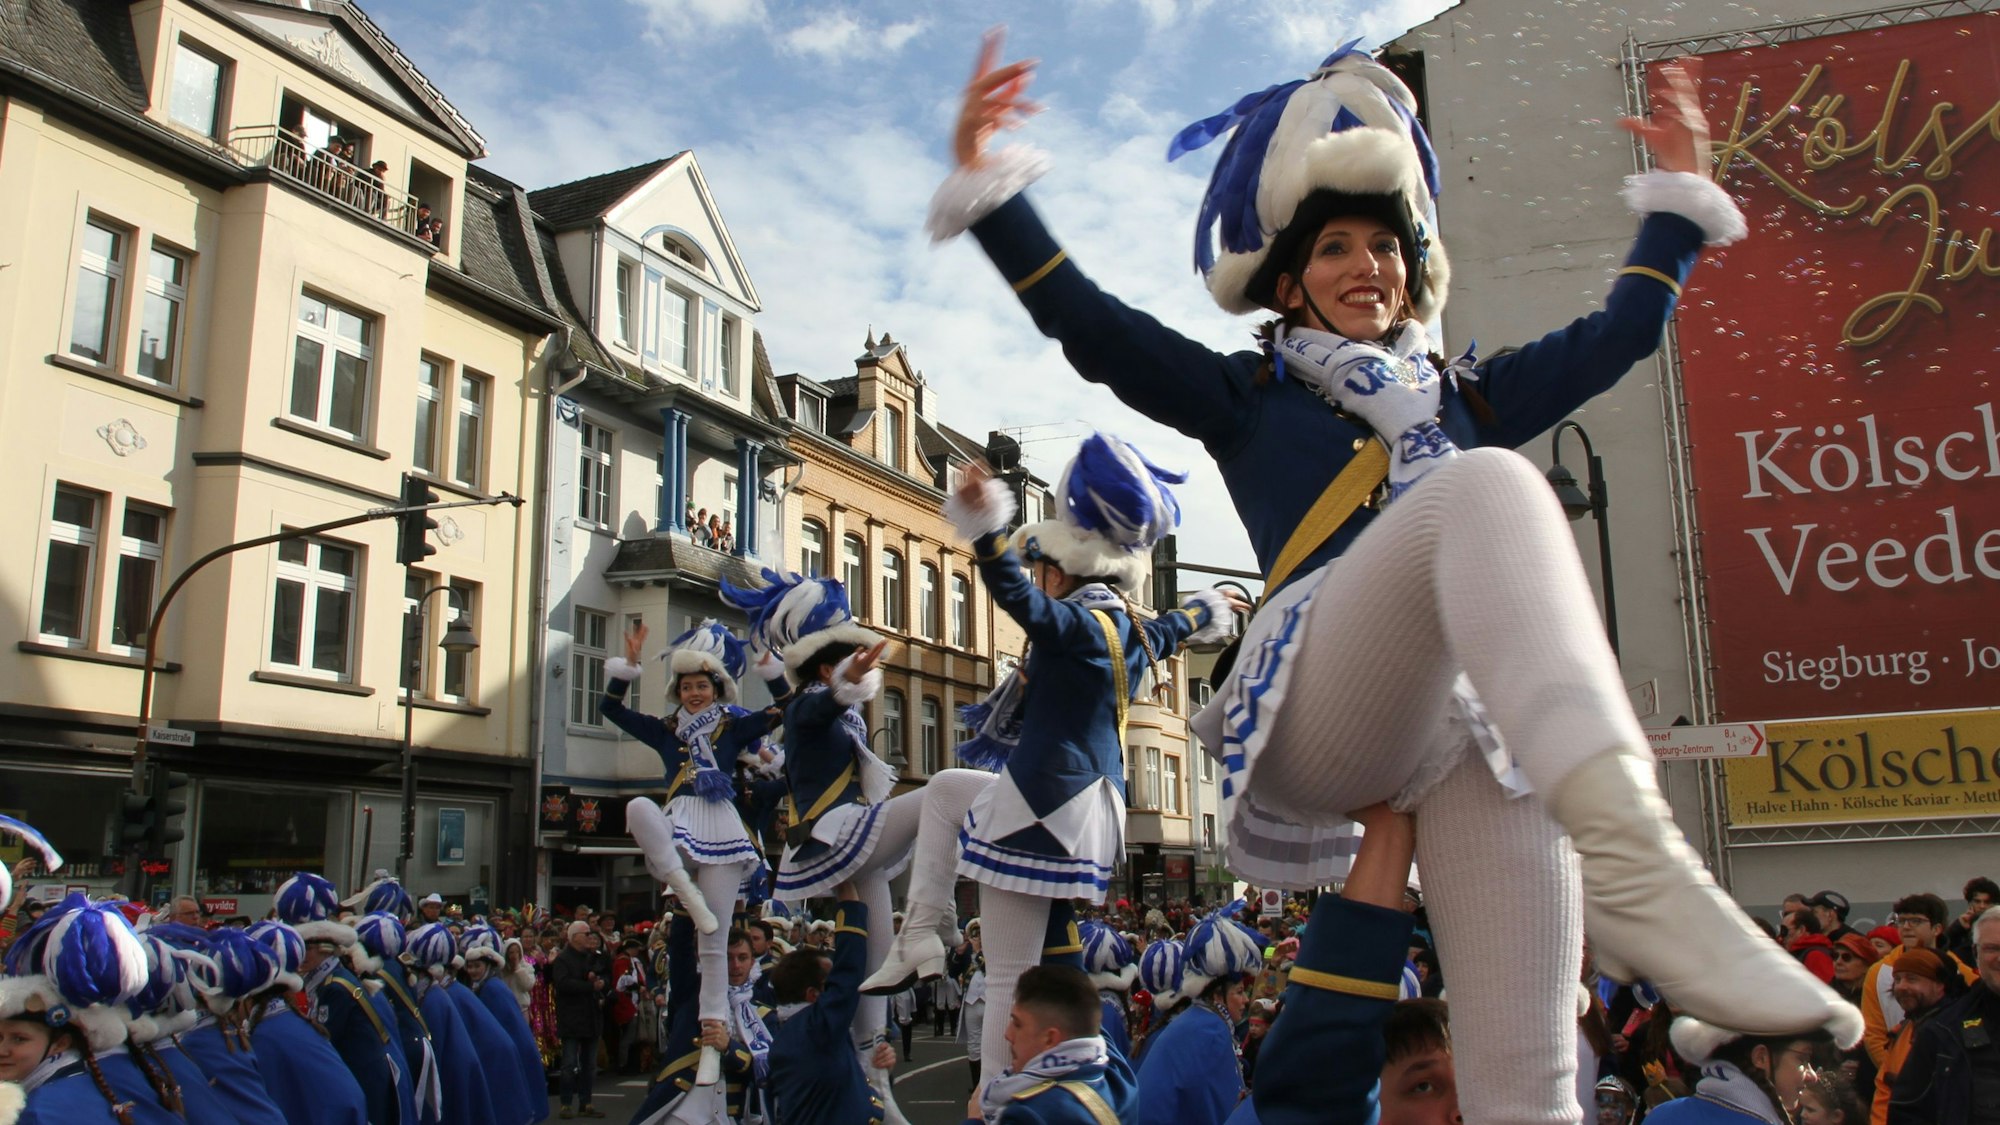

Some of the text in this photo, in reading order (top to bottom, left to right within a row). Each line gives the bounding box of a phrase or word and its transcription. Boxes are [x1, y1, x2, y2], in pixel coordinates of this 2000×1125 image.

[1707, 58, 2000, 217] Köls
[1763, 645, 1931, 690] Siegburg
[1645, 731, 1671, 741] nnef
[1651, 744, 1714, 757] iegburg-Zentrum
[1766, 727, 2000, 794] Kölsch
[1747, 802, 1787, 815] Halve
[1791, 799, 1830, 812] Hahn
[1842, 794, 1898, 810] Kölsche
[1903, 792, 1951, 807] Kaviar
